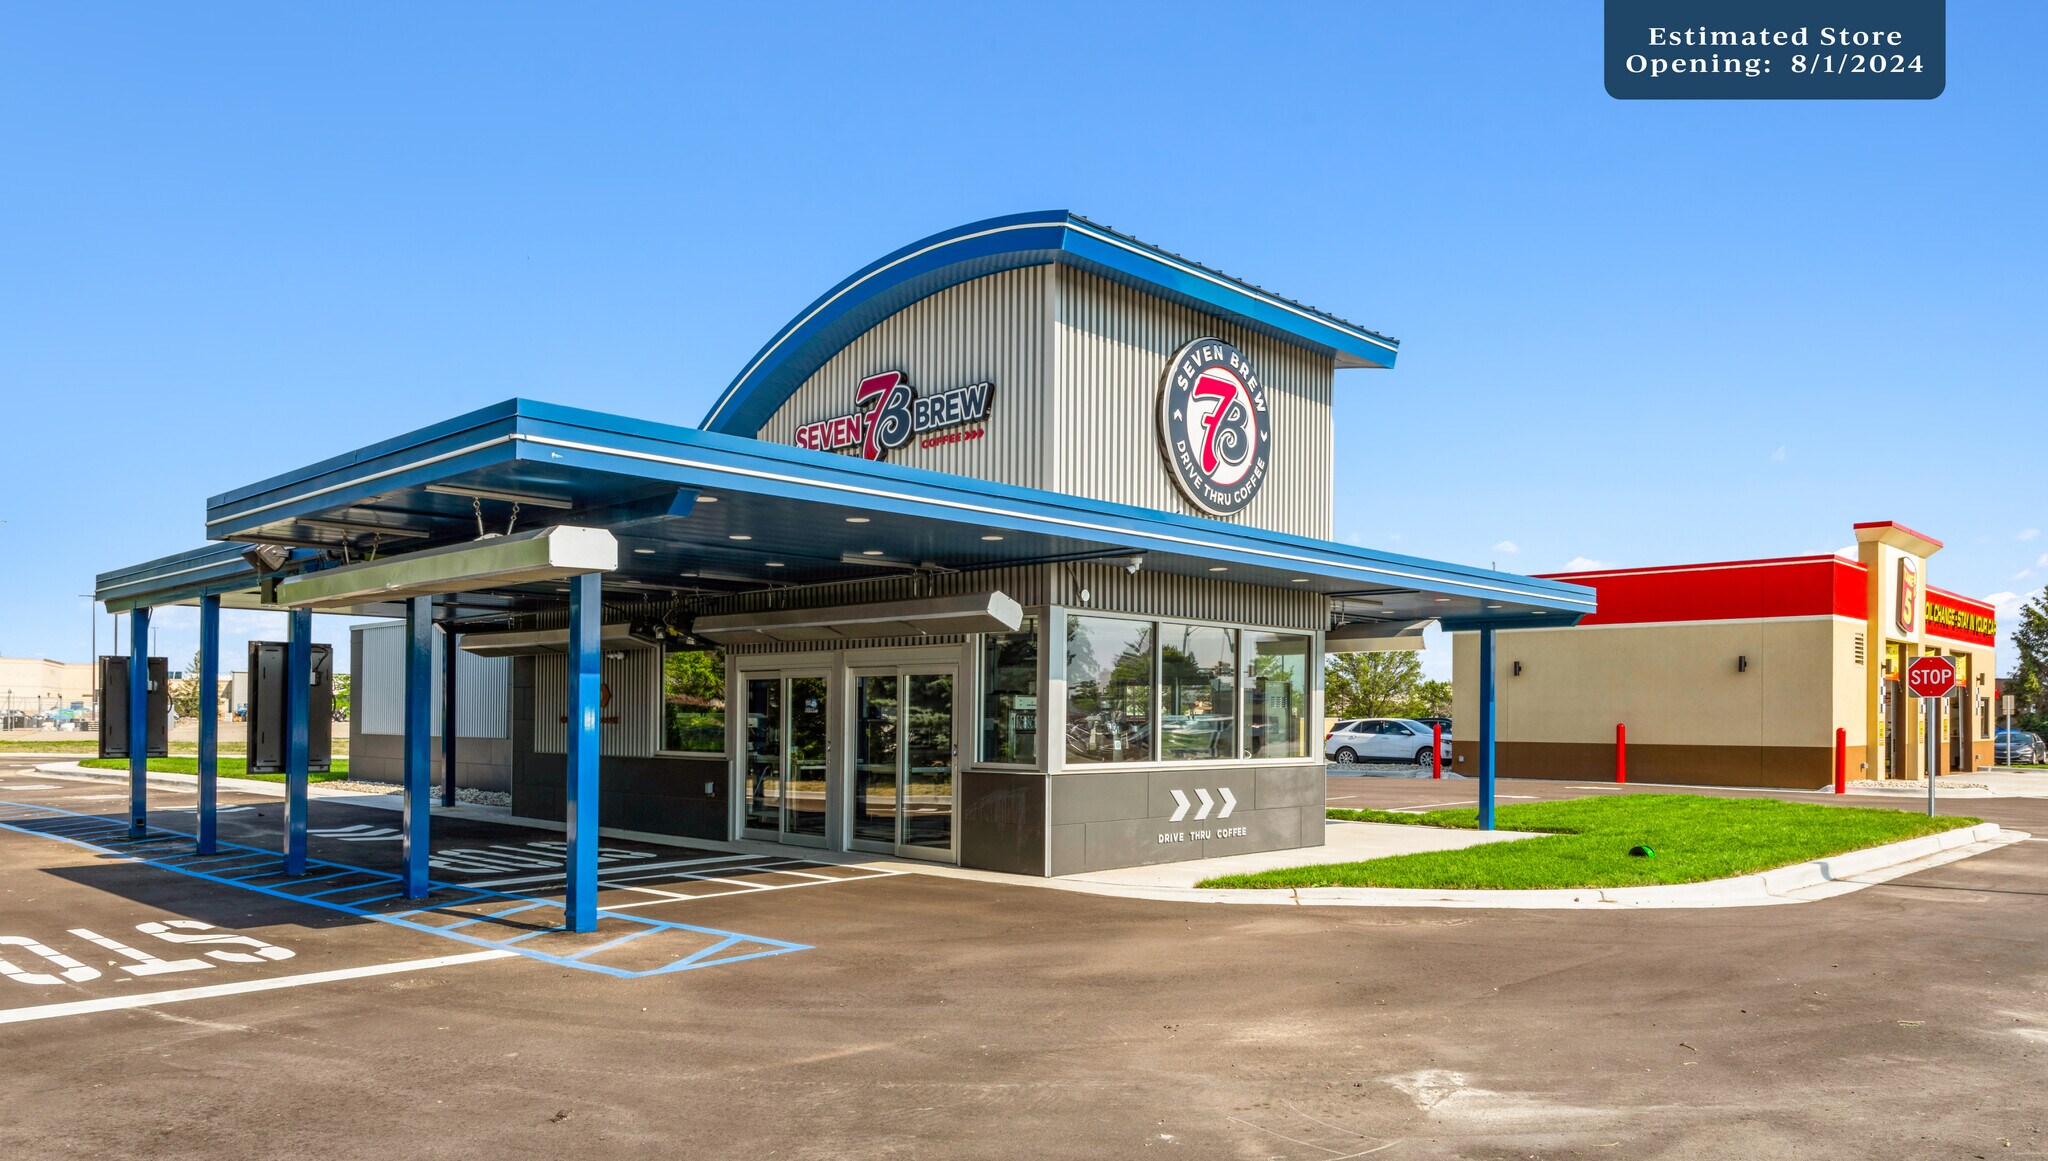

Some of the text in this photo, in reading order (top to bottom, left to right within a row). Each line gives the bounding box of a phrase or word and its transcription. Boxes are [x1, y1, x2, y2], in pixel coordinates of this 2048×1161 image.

[1177, 344, 1266, 412] SEVEN BREW
[796, 413, 862, 451] SEVEN
[913, 382, 991, 432] BREW
[921, 432, 962, 449] COFFEE
[1176, 440, 1266, 506] DRIVE THRU COFFEE
[1911, 669, 1952, 685] STOP
[1158, 827, 1247, 844] DRIVE THRU COFFEE
